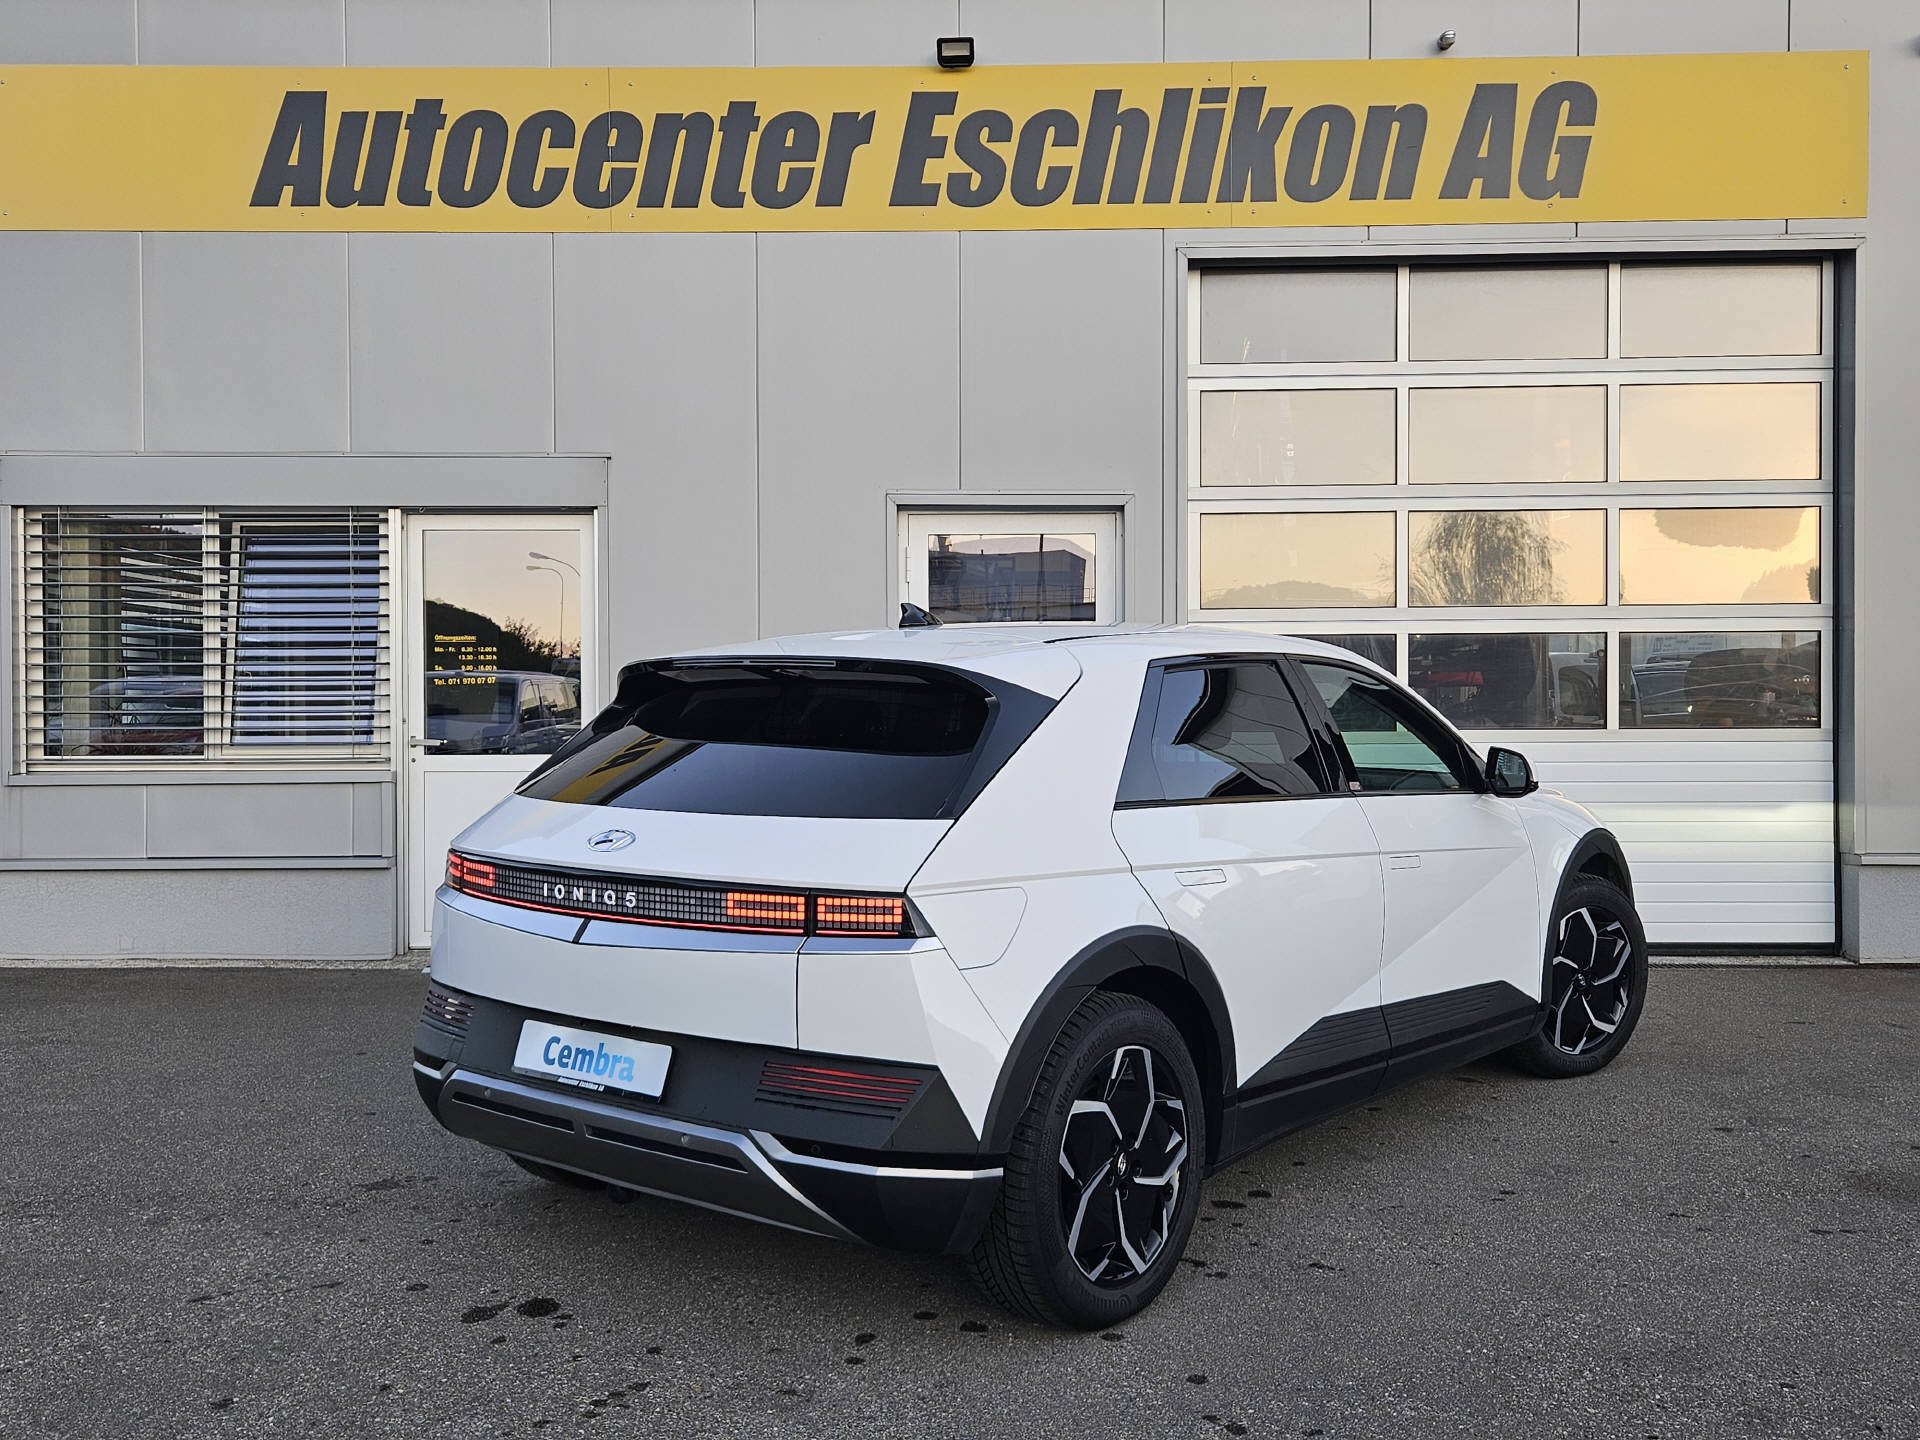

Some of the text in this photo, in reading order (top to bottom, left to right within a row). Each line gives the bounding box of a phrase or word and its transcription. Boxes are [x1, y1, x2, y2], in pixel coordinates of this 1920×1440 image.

[249, 80, 1598, 209] Autocenter Eschlikon AG
[434, 678, 446, 686] Tel.
[462, 677, 476, 685] 970
[487, 676, 497, 684] 07
[543, 1035, 636, 1083] Cembra
